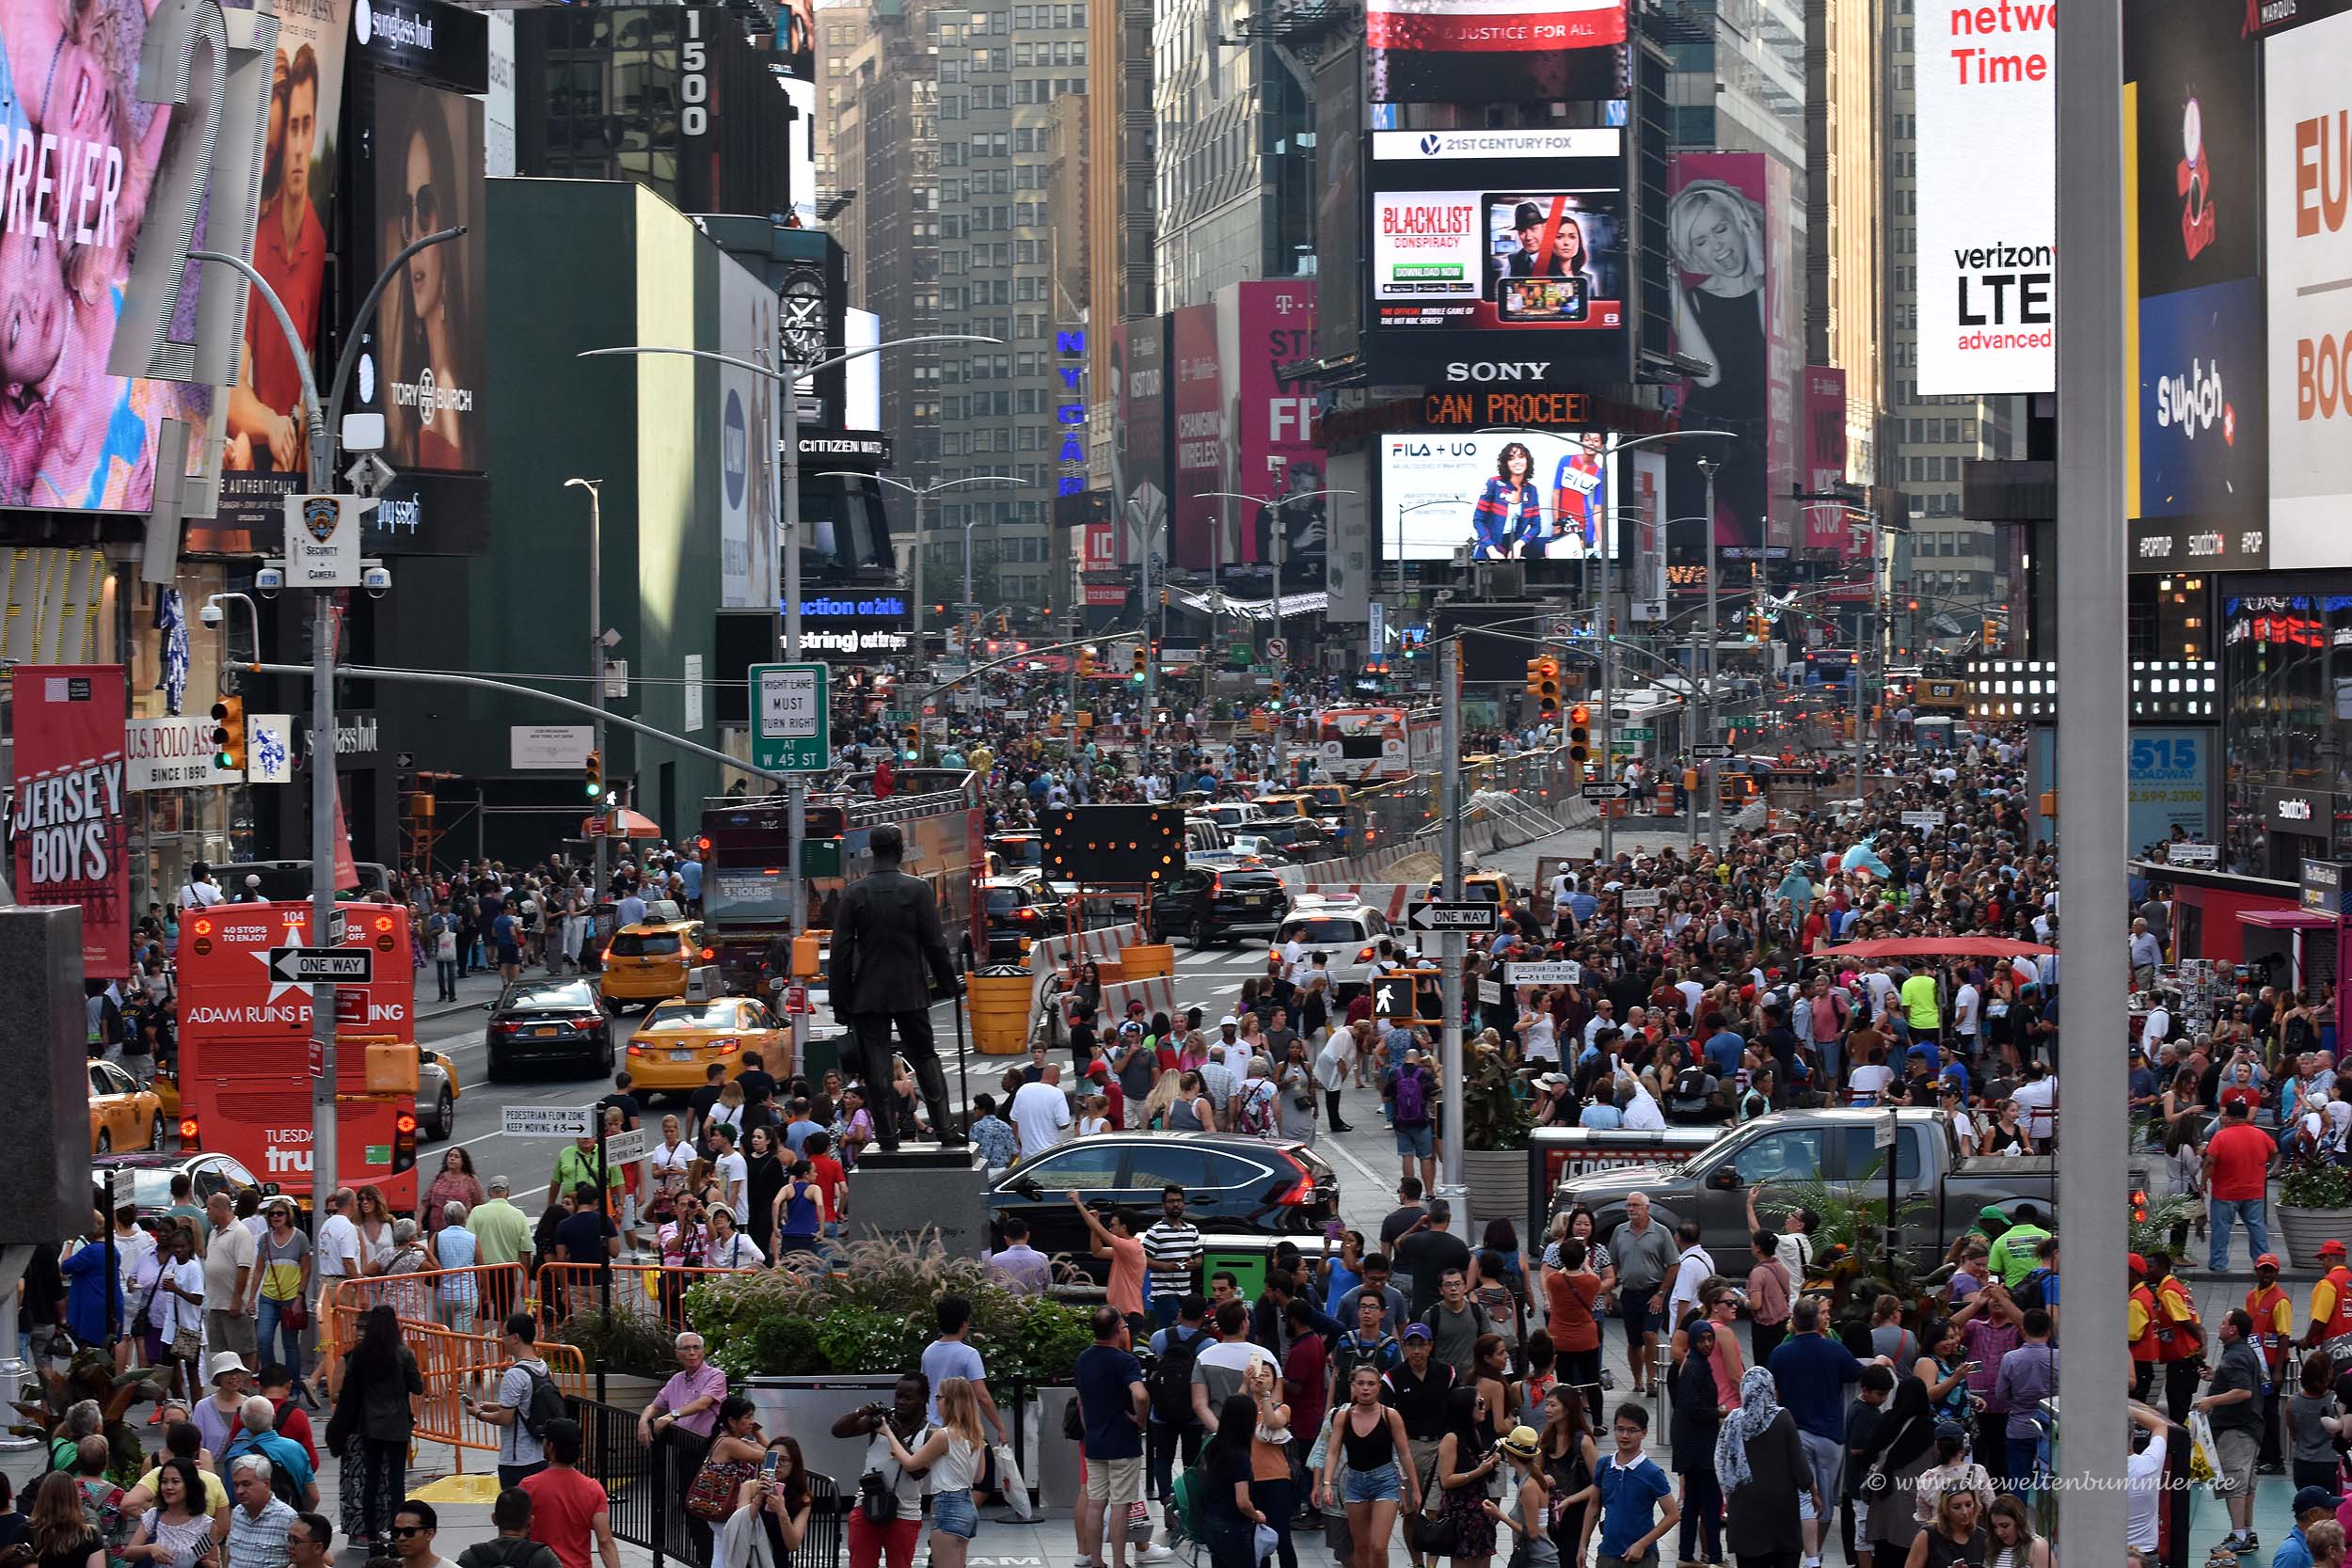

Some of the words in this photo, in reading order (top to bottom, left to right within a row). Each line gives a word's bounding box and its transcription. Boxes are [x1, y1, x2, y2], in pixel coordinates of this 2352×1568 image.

[372, 8, 415, 49] sunglass
[415, 13, 433, 50] hut
[1459, 26, 1527, 40] JUSTICE
[1534, 25, 1565, 38] FOR
[1569, 23, 1595, 36] ALL
[681, 9, 707, 136] 1500
[1950, 48, 2047, 85] Time
[1447, 138, 1477, 150] 21ST
[1479, 137, 1543, 150] CENTURY
[1545, 136, 1572, 149] FOX
[2295, 109, 2352, 238] EU
[1383, 206, 1473, 233] BLACKLIST
[1394, 237, 1460, 248] CONSPIRACY
[1954, 241, 2051, 270] verizon
[1395, 268, 1440, 277] DOWNLOAD
[1441, 267, 1461, 277] NOW
[1958, 274, 2051, 326] LTE
[1958, 328, 2052, 351] advanced
[1446, 362, 1550, 382] SONY
[391, 381, 419, 407] TORY
[437, 384, 472, 412] BURCH
[2157, 357, 2223, 440] swatch
[1426, 393, 1473, 423] CAN
[799, 439, 859, 452] CITIZEN
[1392, 443, 1431, 457] FILA
[1451, 442, 1477, 456] UO
[229, 480, 298, 496] AUTHENTICALLY
[1814, 500, 1842, 533] STOP
[307, 546, 339, 556] SECURITY
[309, 569, 337, 579] CAMERA
[763, 677, 787, 689] RIGHT
[790, 677, 813, 689] LANE
[1933, 686, 1951, 697] CAT
[772, 698, 803, 710] MUST
[763, 718, 787, 729] TURN
[789, 718, 815, 730] RIGHT
[357, 715, 378, 753] hut
[1634, 729, 1644, 739] 45
[126, 728, 151, 760] U.S.
[153, 725, 188, 759] POLO
[783, 739, 795, 751] AT
[763, 753, 776, 766] W
[778, 753, 796, 767] 45
[802, 752, 818, 766] ST
[2130, 738, 2196, 768] 515
[151, 768, 180, 782] SINCE
[183, 766, 207, 781] 1890
[17, 760, 122, 831] JERSEY
[32, 819, 108, 883] BOYS
[733, 887, 772, 896] HOURS
[282, 911, 305, 922] 104
[1434, 911, 1460, 923] ONE
[1462, 911, 1487, 922] WAY
[223, 926, 236, 934] 40
[237, 926, 267, 934] STOPS
[236, 934, 268, 942] ENJOY
[300, 958, 327, 972] ONE
[333, 958, 361, 973] WAY
[186, 1006, 242, 1023] ADAM
[246, 1006, 295, 1023] RUINS
[506, 1111, 547, 1120] PEDESTRIAN
[548, 1111, 566, 1120] FLOW
[568, 1111, 586, 1121] ZONE
[506, 1123, 523, 1132] KEEP
[525, 1123, 550, 1132] MOVING
[264, 1129, 314, 1144] TUESDA
